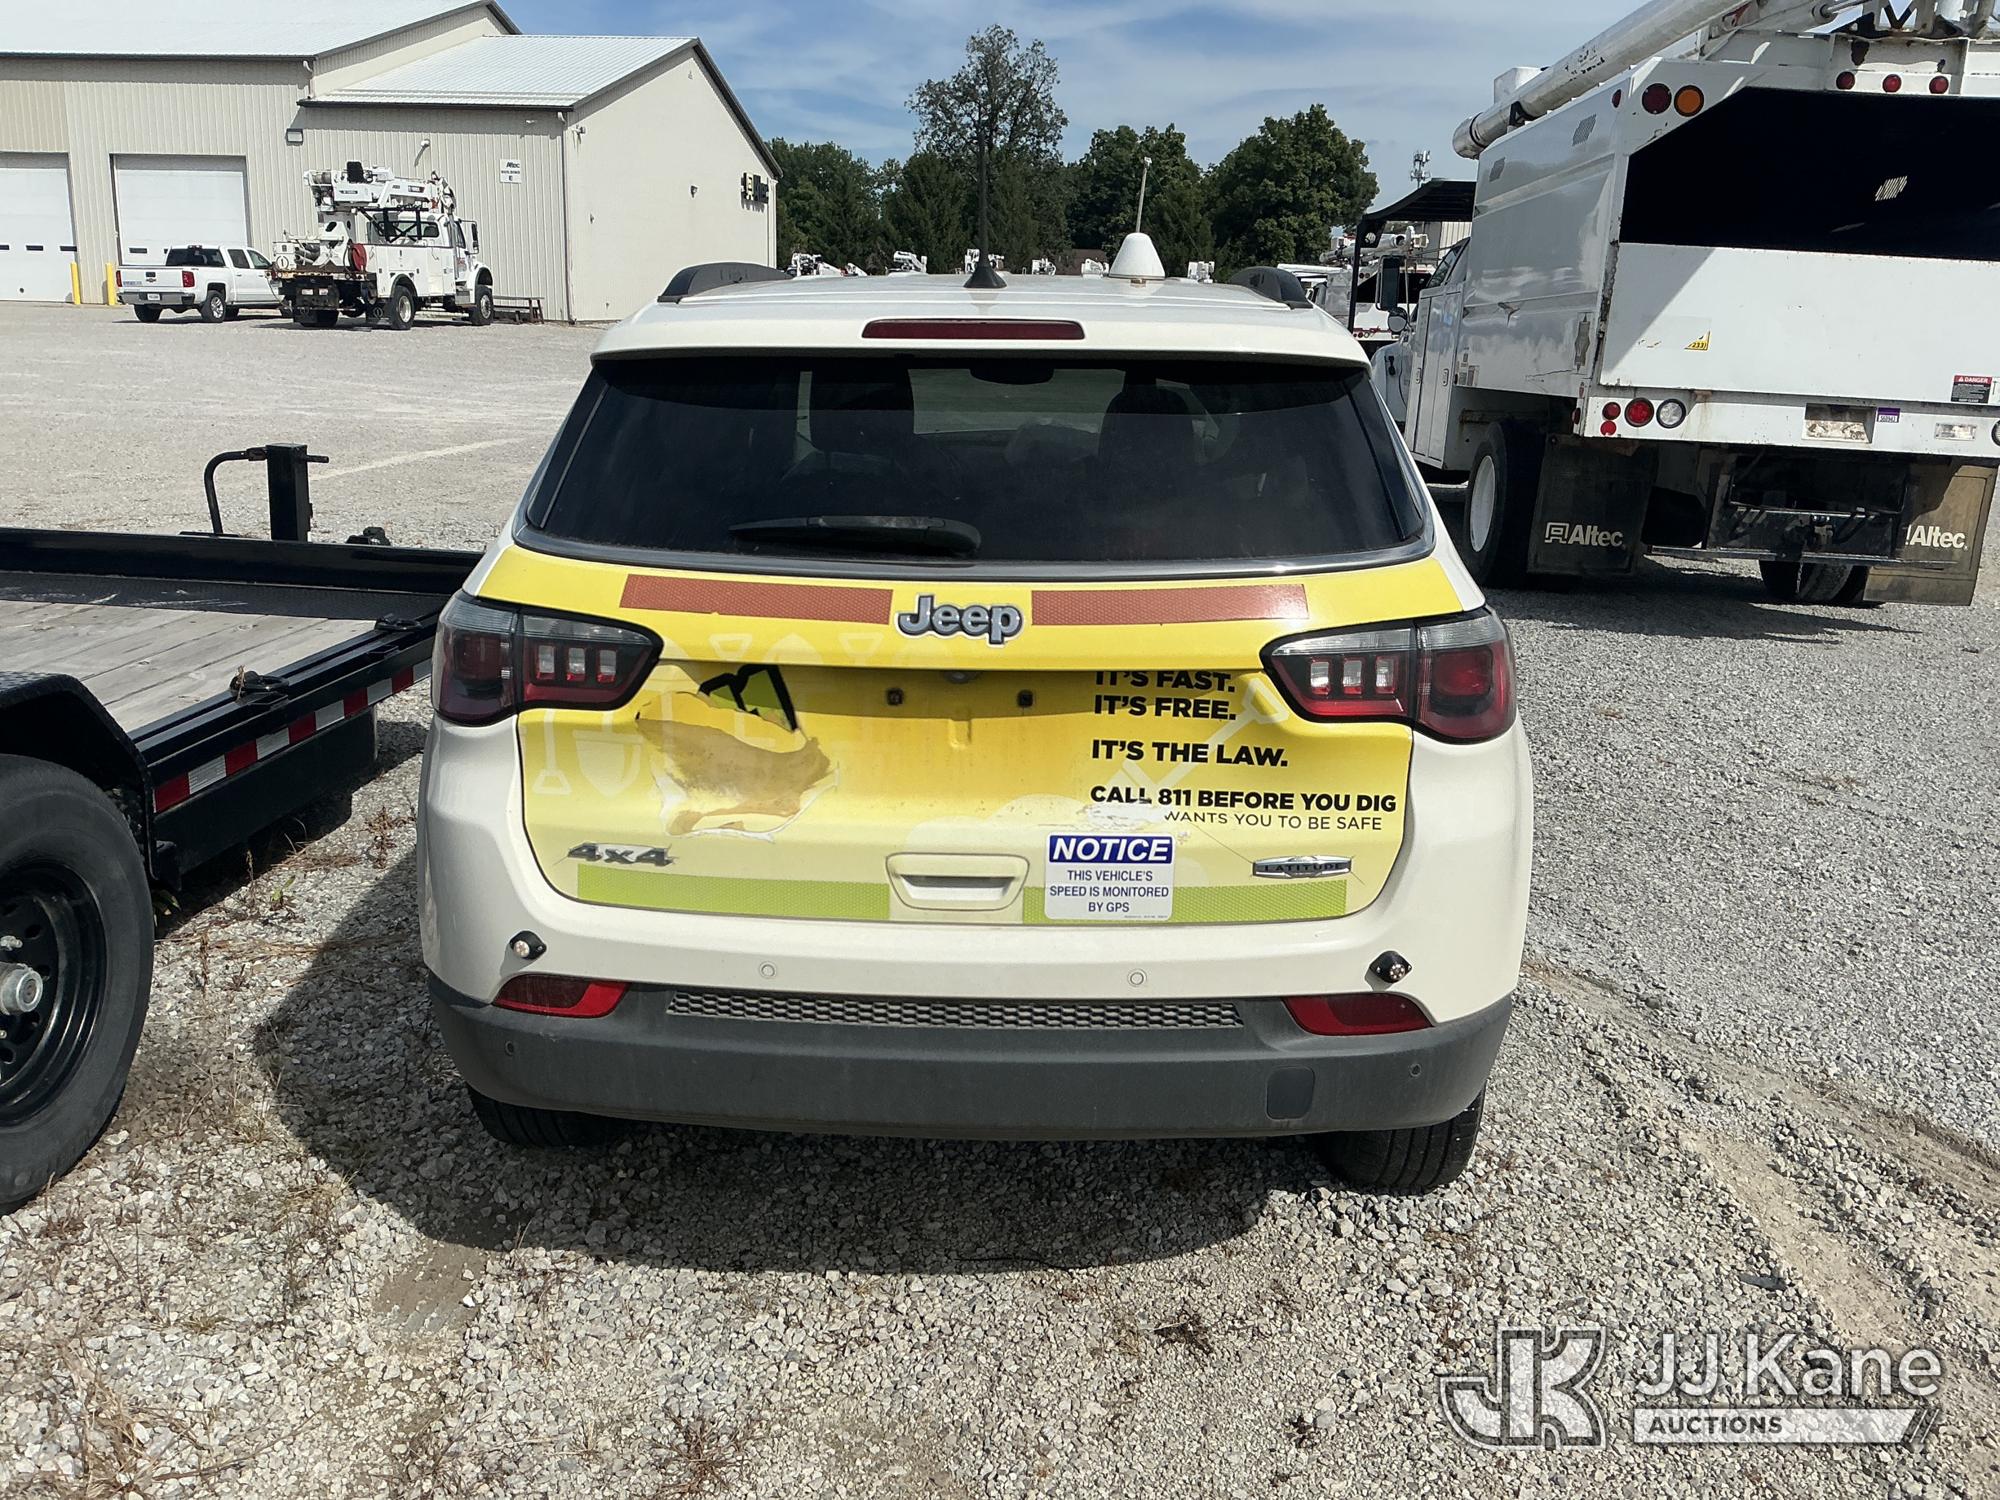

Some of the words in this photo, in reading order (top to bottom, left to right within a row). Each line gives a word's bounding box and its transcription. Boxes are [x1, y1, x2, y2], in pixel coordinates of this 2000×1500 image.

[1568, 524, 1623, 547] Altec
[1909, 525, 1966, 549] Altec
[898, 595, 1023, 645] Jeep
[1156, 671, 1235, 692] FAST.
[1094, 695, 1147, 716] IT'S
[1155, 698, 1236, 720] FREE.
[1092, 740, 1144, 760] IT'S
[1152, 742, 1208, 762] THE
[1216, 744, 1288, 767] LAW.
[1090, 785, 1152, 805] CALL
[1157, 788, 1191, 807] 811
[1197, 790, 1294, 809] BEFORE
[1300, 793, 1350, 811] YOU
[1356, 795, 1396, 812] DIG
[1164, 811, 1228, 824] WANTS
[1234, 814, 1272, 827] YOU
[1278, 815, 1302, 829] TO
[1308, 816, 1330, 830] BE
[1336, 816, 1382, 830] SAFE
[567, 842, 673, 867] 4x4
[1053, 837, 1170, 861] NOTICE
[1067, 870, 1092, 881] THIS
[1095, 870, 1153, 881] VEHICLE'S
[1263, 861, 1345, 872] LATITUDE
[1049, 885, 1087, 897] SPEED
[1089, 886, 1100, 897] IS
[1102, 886, 1169, 898] MONITORED
[1088, 901, 1103, 913] BY
[1106, 901, 1130, 913] GPS
